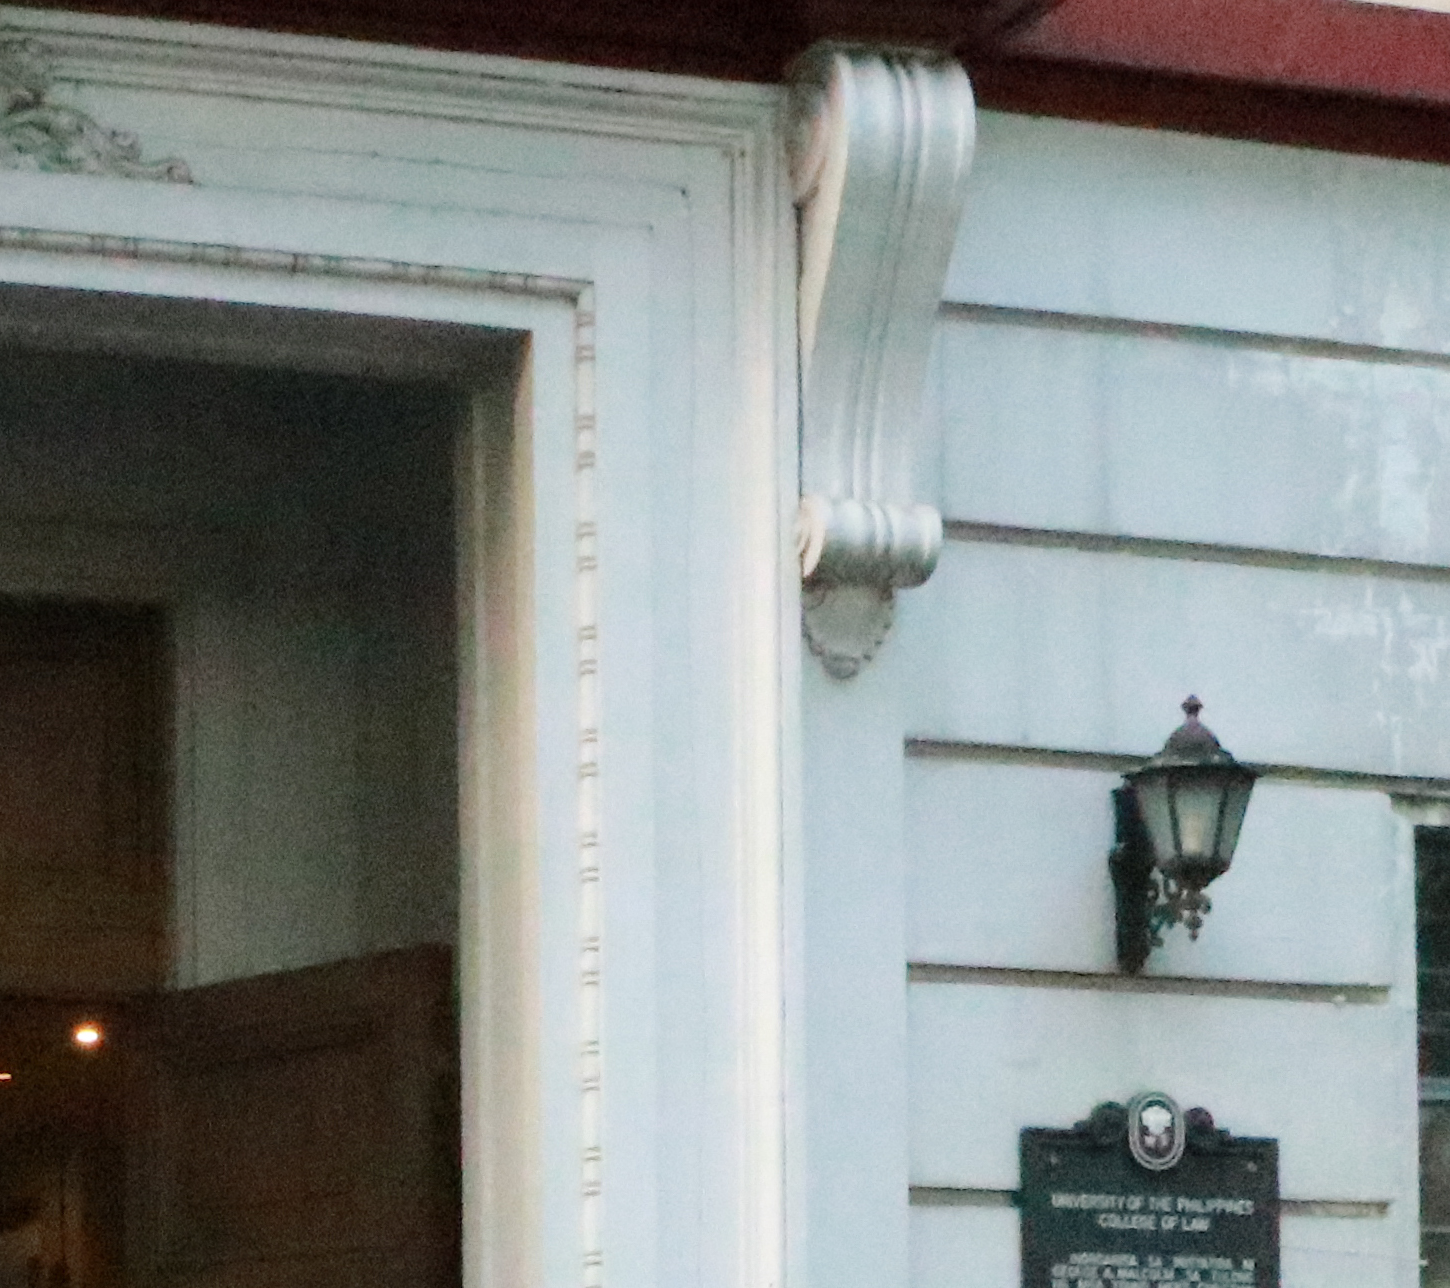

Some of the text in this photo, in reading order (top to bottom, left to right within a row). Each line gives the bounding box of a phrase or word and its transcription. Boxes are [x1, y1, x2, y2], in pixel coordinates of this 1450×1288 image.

[1051, 1192, 1255, 1216] UNIVERSITY OF THE PHILIPPINES
[1098, 1213, 1210, 1232] COLLEGE OF LAW
